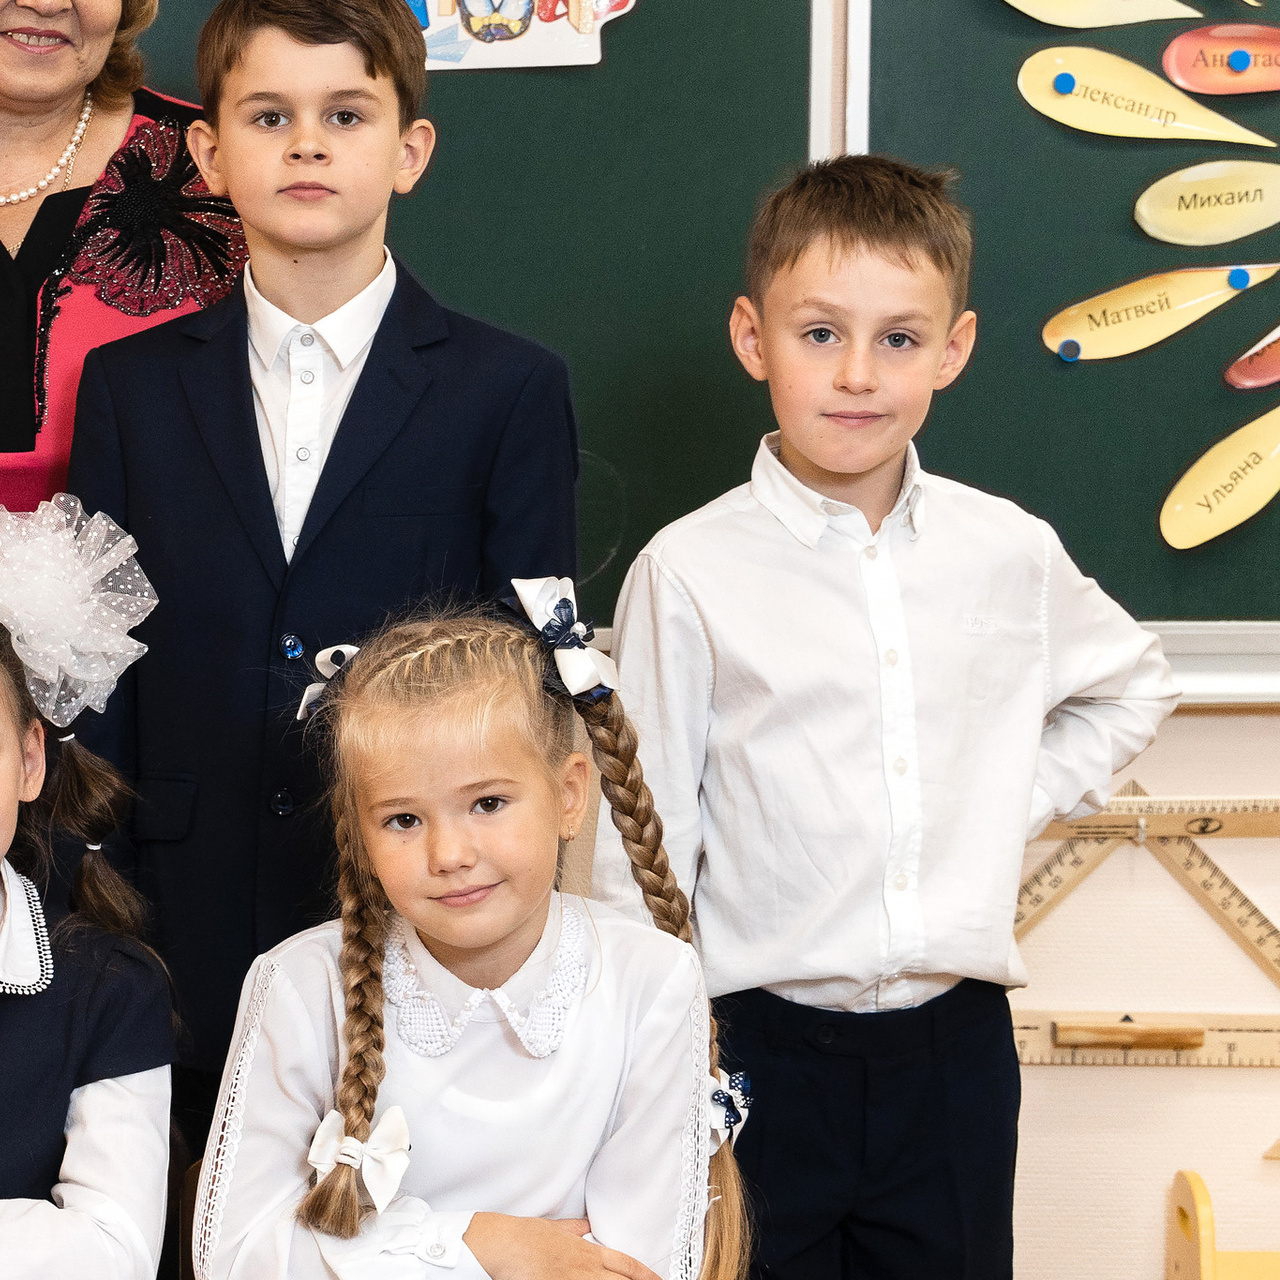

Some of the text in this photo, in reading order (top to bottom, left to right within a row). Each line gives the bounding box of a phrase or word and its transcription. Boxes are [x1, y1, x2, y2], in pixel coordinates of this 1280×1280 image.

[1057, 78, 1177, 128] лександр
[1176, 187, 1265, 212] Михаил
[1086, 292, 1172, 331] Матвей
[1195, 450, 1264, 513] Ульяна
